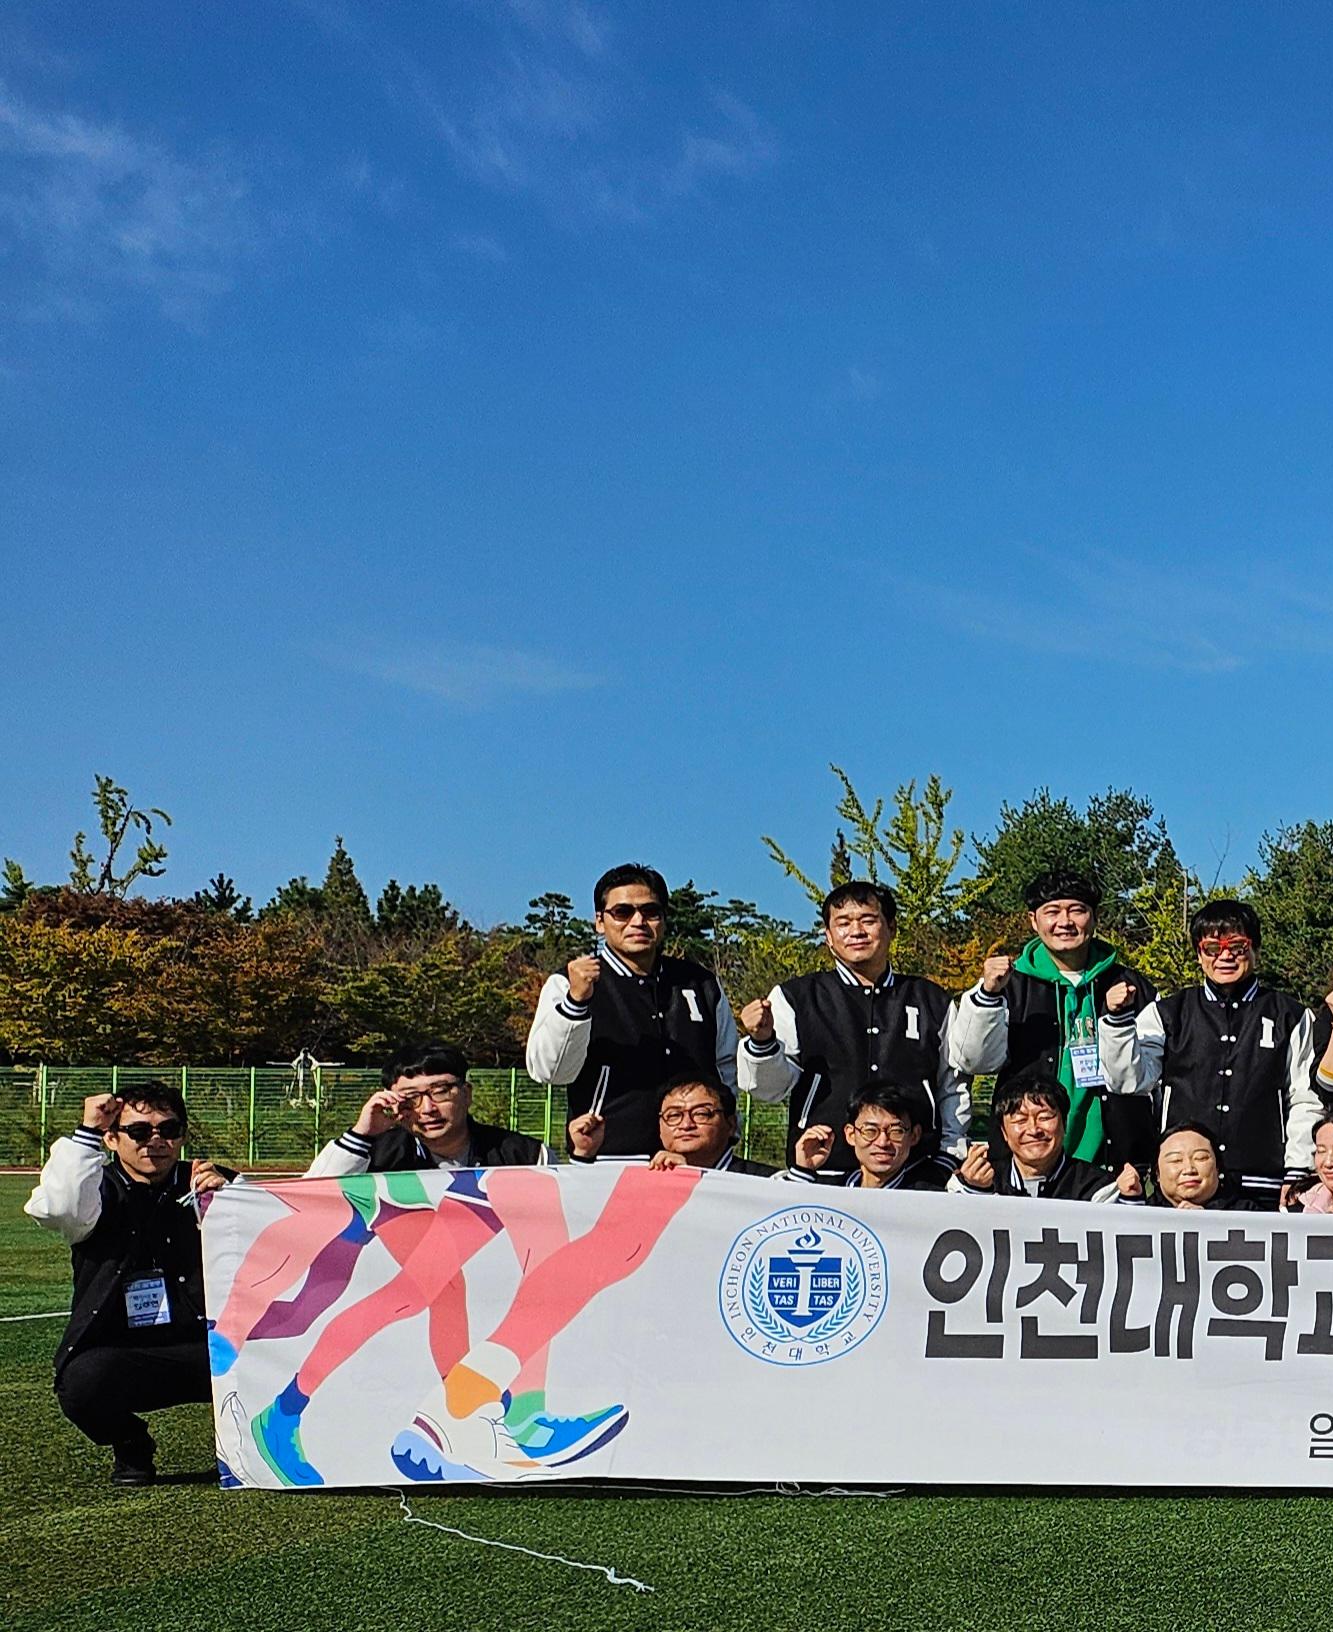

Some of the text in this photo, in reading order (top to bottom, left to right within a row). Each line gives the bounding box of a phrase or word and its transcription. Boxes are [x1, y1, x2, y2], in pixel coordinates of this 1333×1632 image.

[727, 1211, 882, 1322] INCHEON NATIONAL UNIVERSITY
[772, 1277, 797, 1288] VERI
[812, 1277, 840, 1288] LIBER
[773, 1294, 795, 1305] TAS
[813, 1294, 834, 1305] TAS
